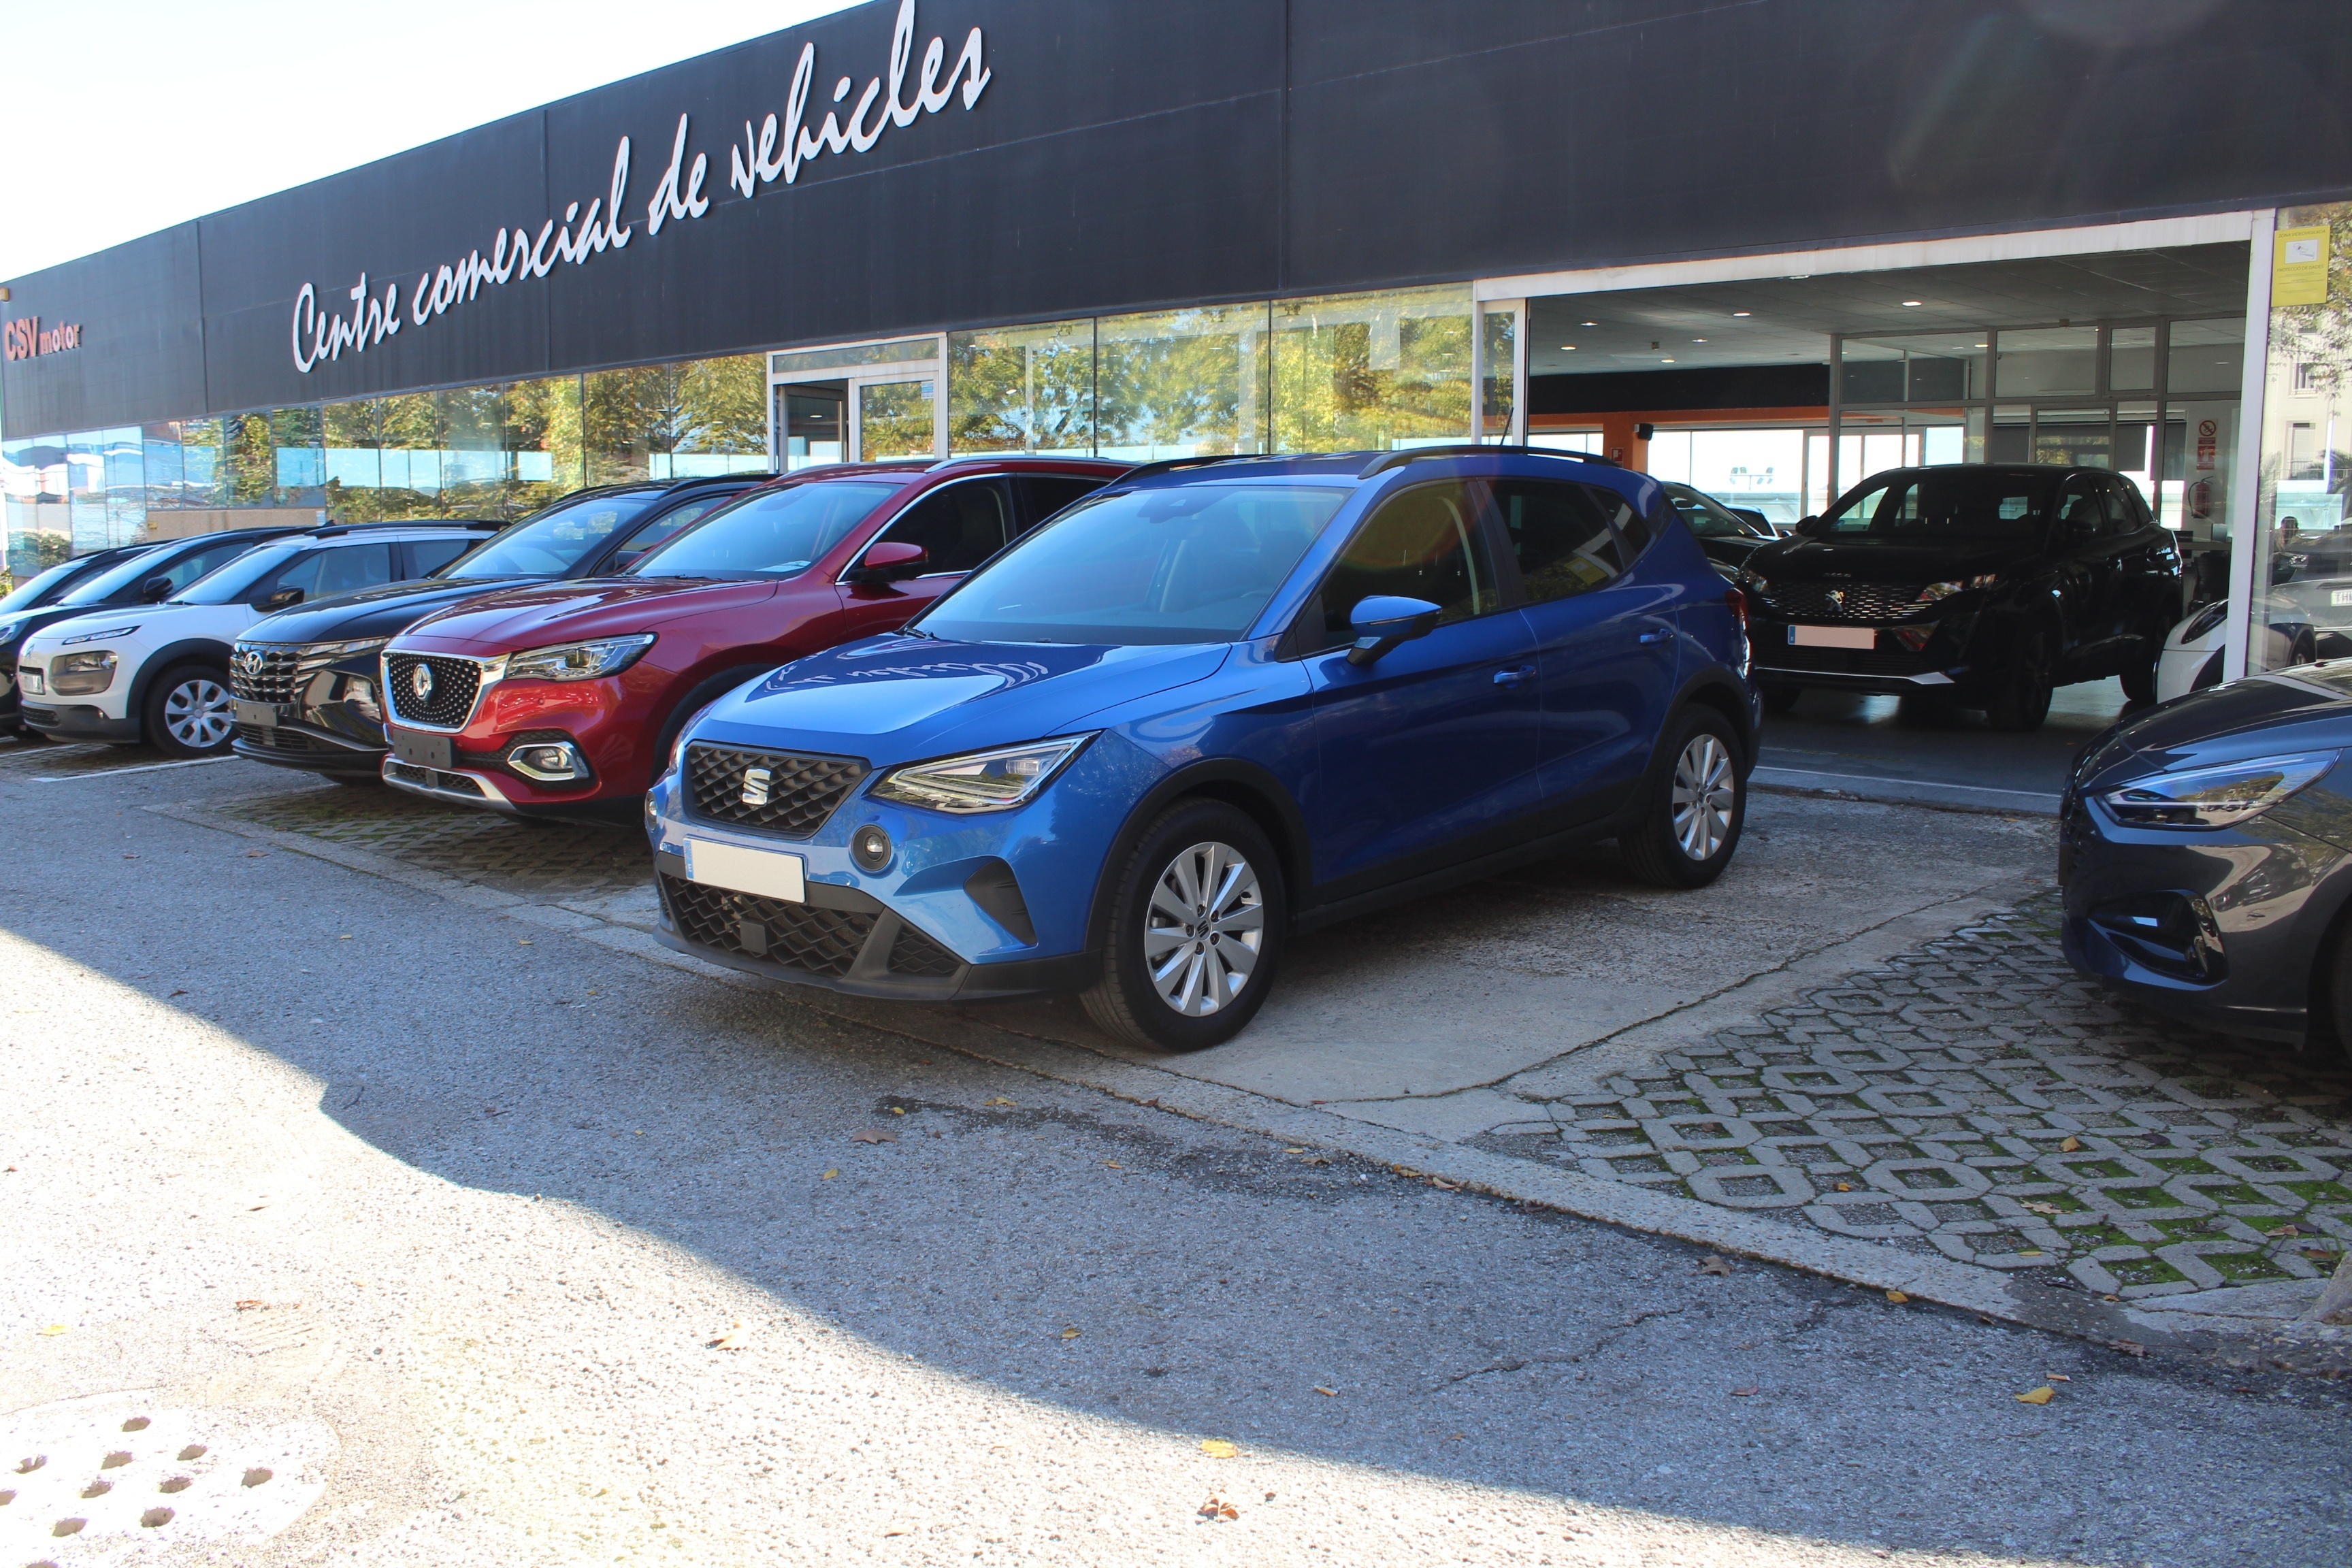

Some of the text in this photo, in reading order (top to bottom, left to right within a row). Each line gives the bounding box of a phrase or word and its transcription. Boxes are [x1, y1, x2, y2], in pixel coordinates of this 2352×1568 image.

[293, 0, 991, 373] Centre comercial de vehicles
[4, 316, 80, 361] CSV motor
